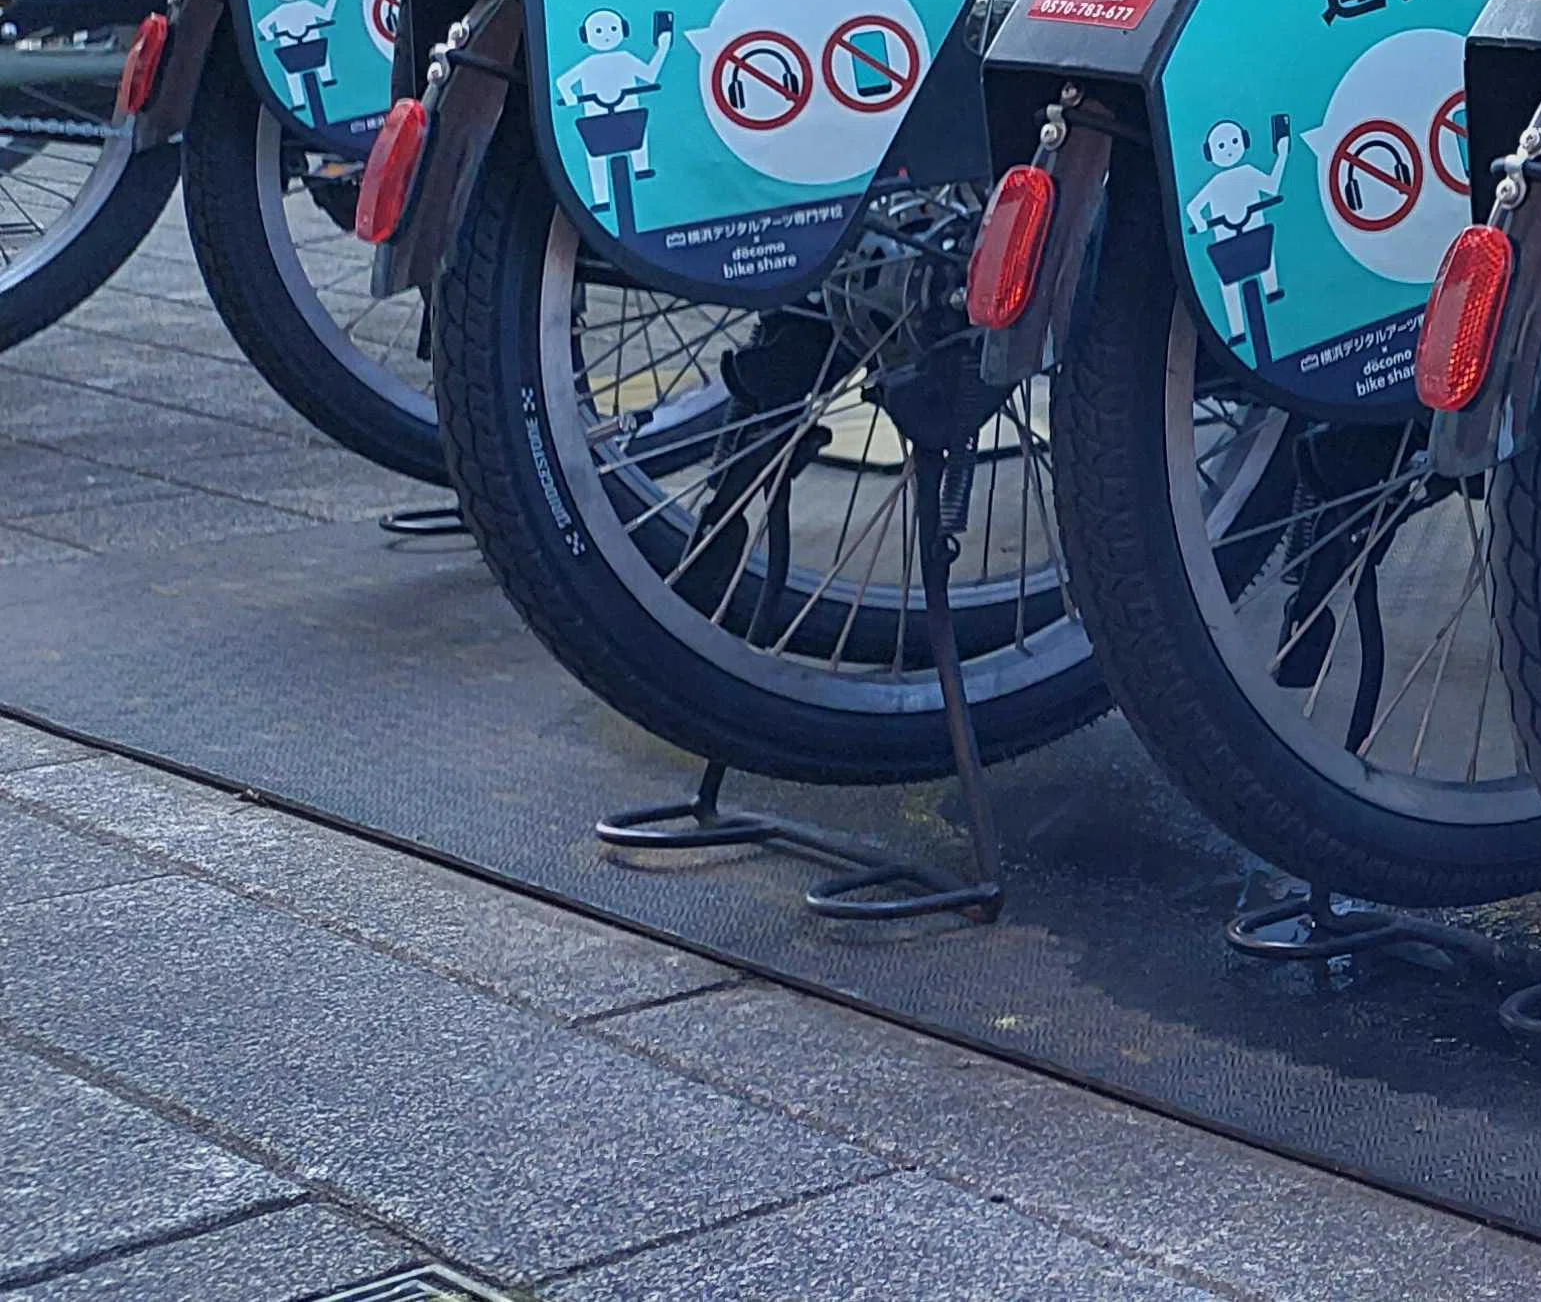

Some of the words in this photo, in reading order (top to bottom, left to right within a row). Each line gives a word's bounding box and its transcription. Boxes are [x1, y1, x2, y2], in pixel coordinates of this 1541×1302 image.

[732, 241, 786, 261] docomo
[723, 262, 755, 280] bike
[757, 254, 797, 273] share
[1320, 313, 1424, 366] 横浜デジタルアーツ
[1363, 349, 1412, 376] docomo
[1356, 376, 1385, 398] bike
[1388, 363, 1415, 385] shar
